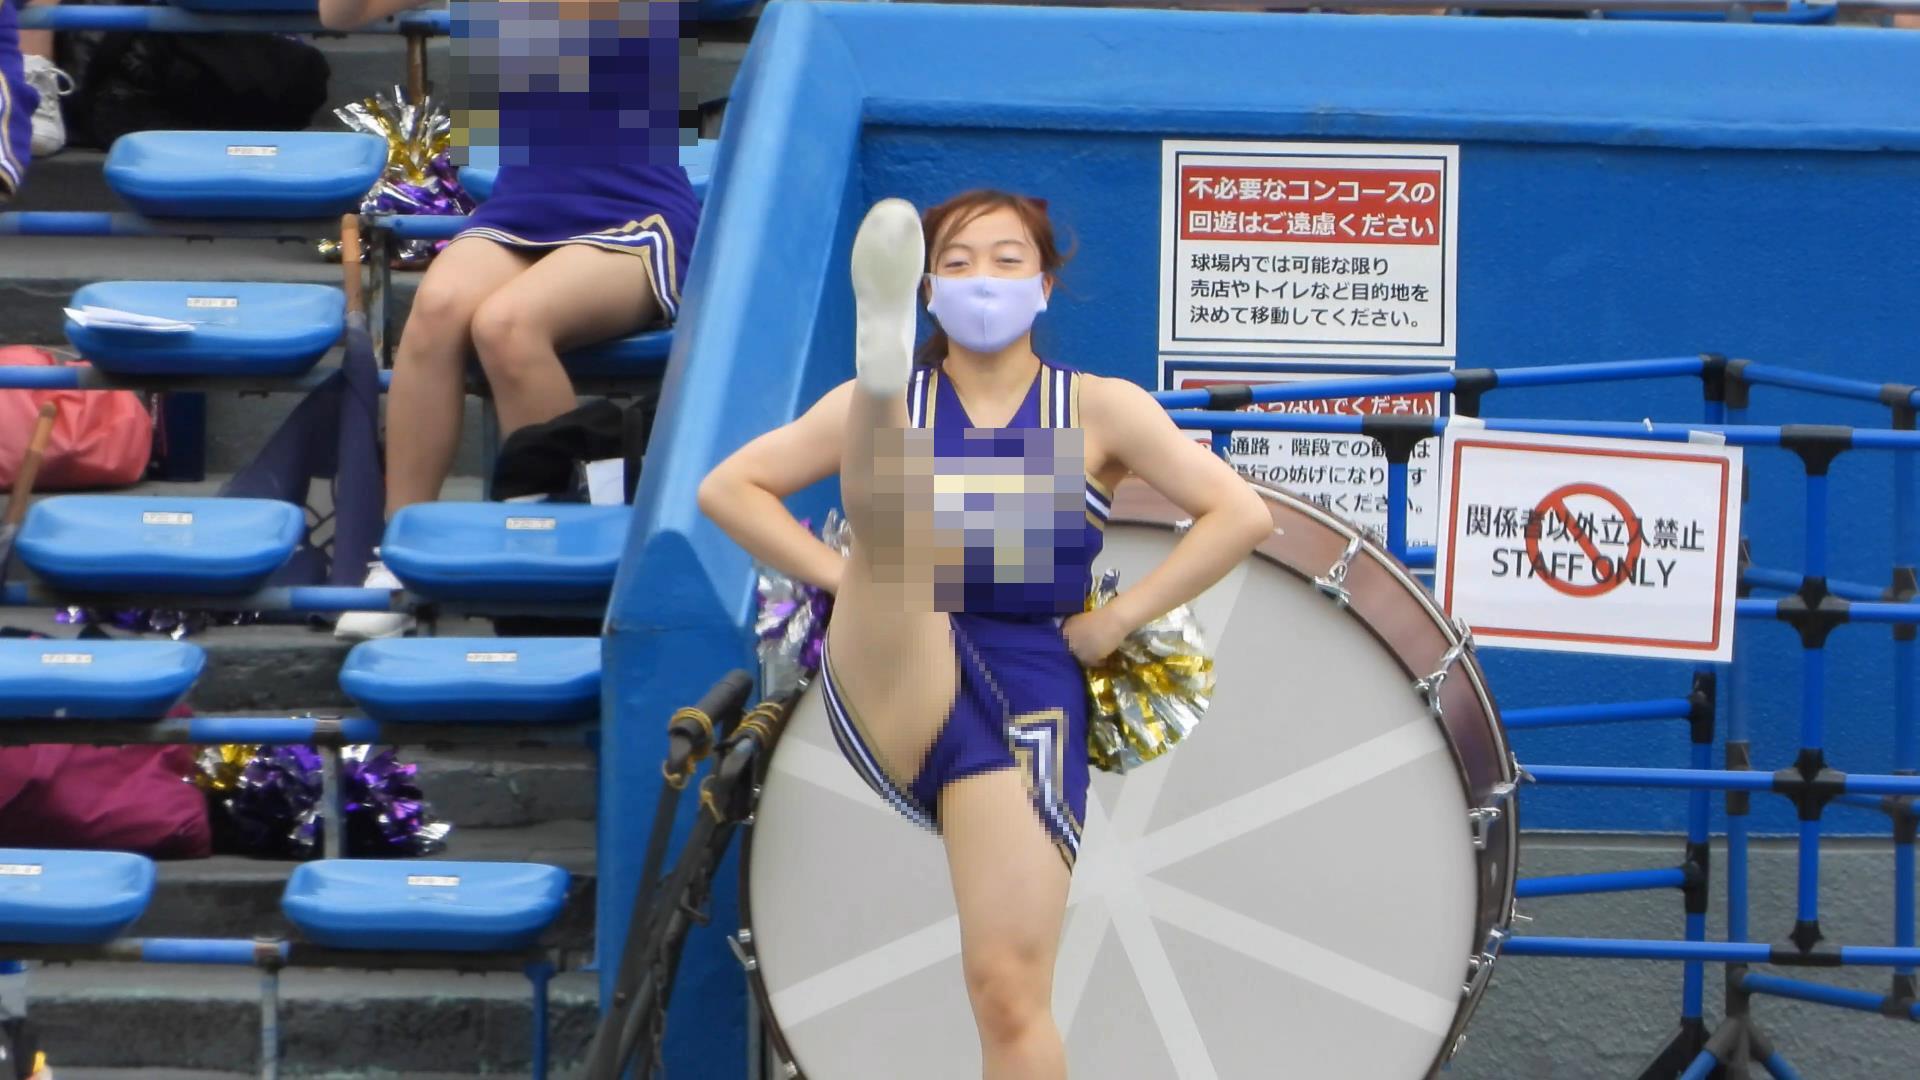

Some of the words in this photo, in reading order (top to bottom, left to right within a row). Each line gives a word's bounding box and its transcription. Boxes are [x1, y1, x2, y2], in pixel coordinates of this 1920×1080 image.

[1188, 177, 1436, 204] 不必要なコンコースの
[1188, 210, 1434, 238] 回遊はご遠慮ください
[1191, 253, 1389, 276] 球場内では可能な限り
[1190, 279, 1429, 302] 売店やトイレなど目的地を
[1190, 305, 1420, 328] 決めて移動してください。
[1466, 503, 1705, 552] 関係者以外立入禁止
[1492, 549, 1584, 582] STAFF
[1592, 555, 1676, 588] ONLY
